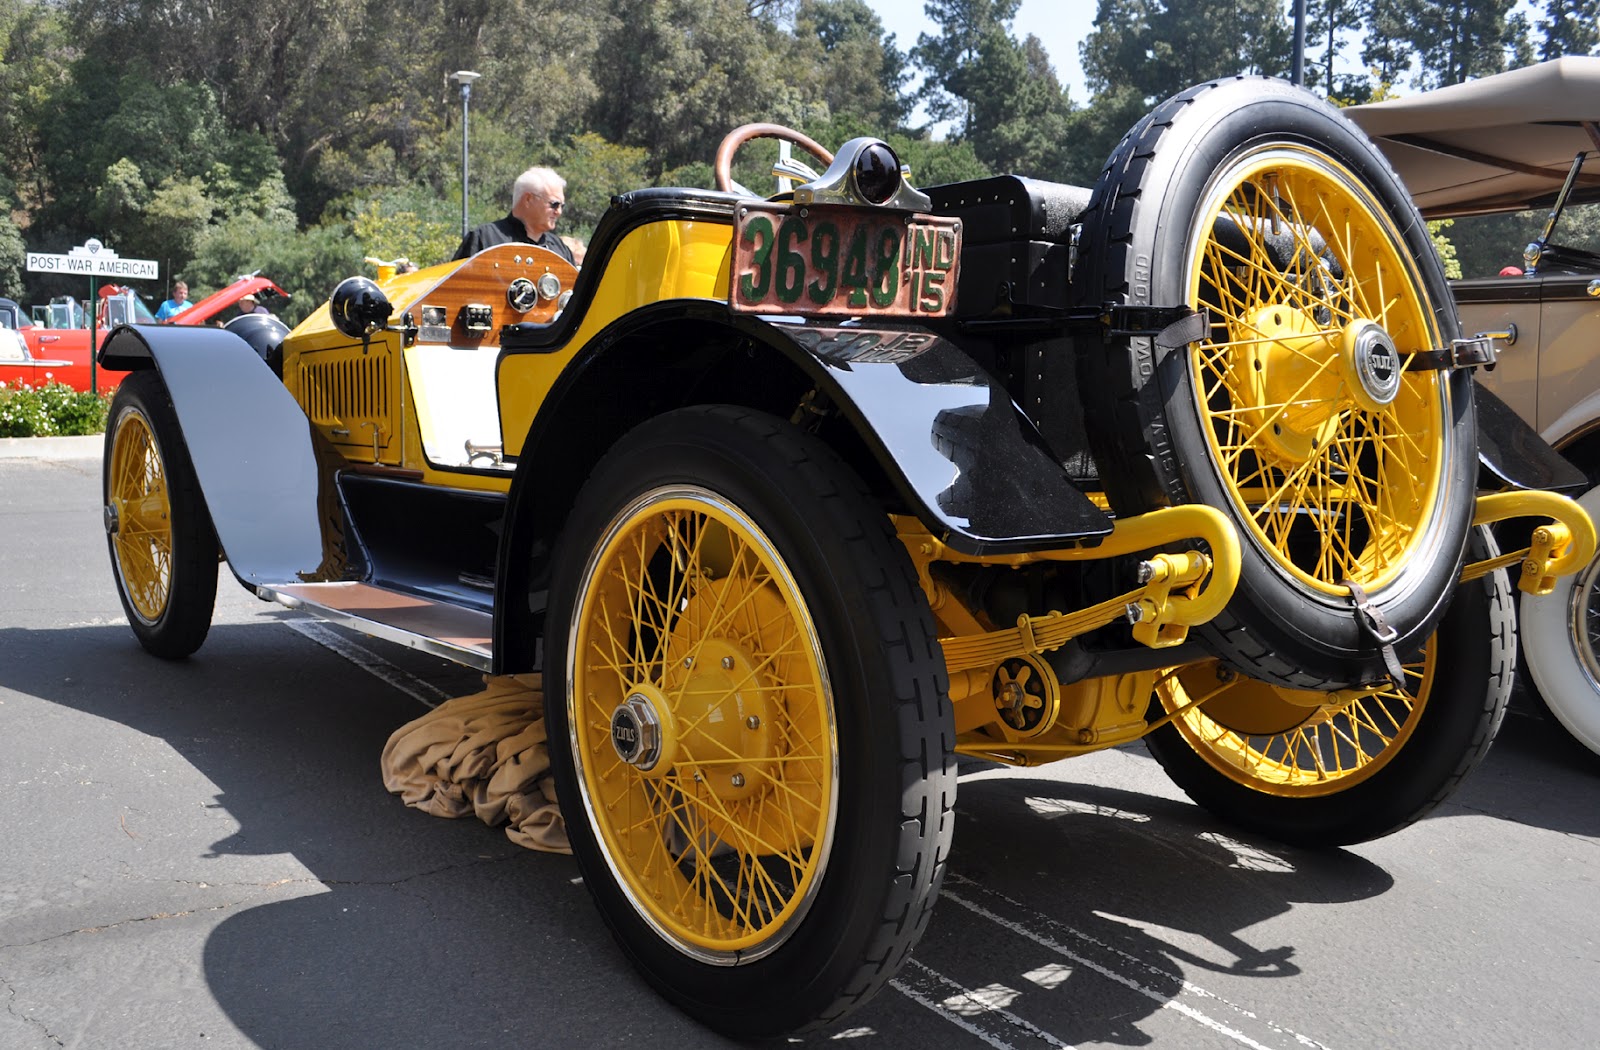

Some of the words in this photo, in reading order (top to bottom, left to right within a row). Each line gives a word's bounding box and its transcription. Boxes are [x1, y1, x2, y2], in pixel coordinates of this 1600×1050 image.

[906, 222, 955, 270] IND
[30, 256, 93, 272] POST-WAR
[98, 261, 155, 276] AMERICAN
[740, 215, 901, 309] 36948
[1371, 354, 1392, 370] STUTZ
[616, 726, 635, 743] STUTZ
